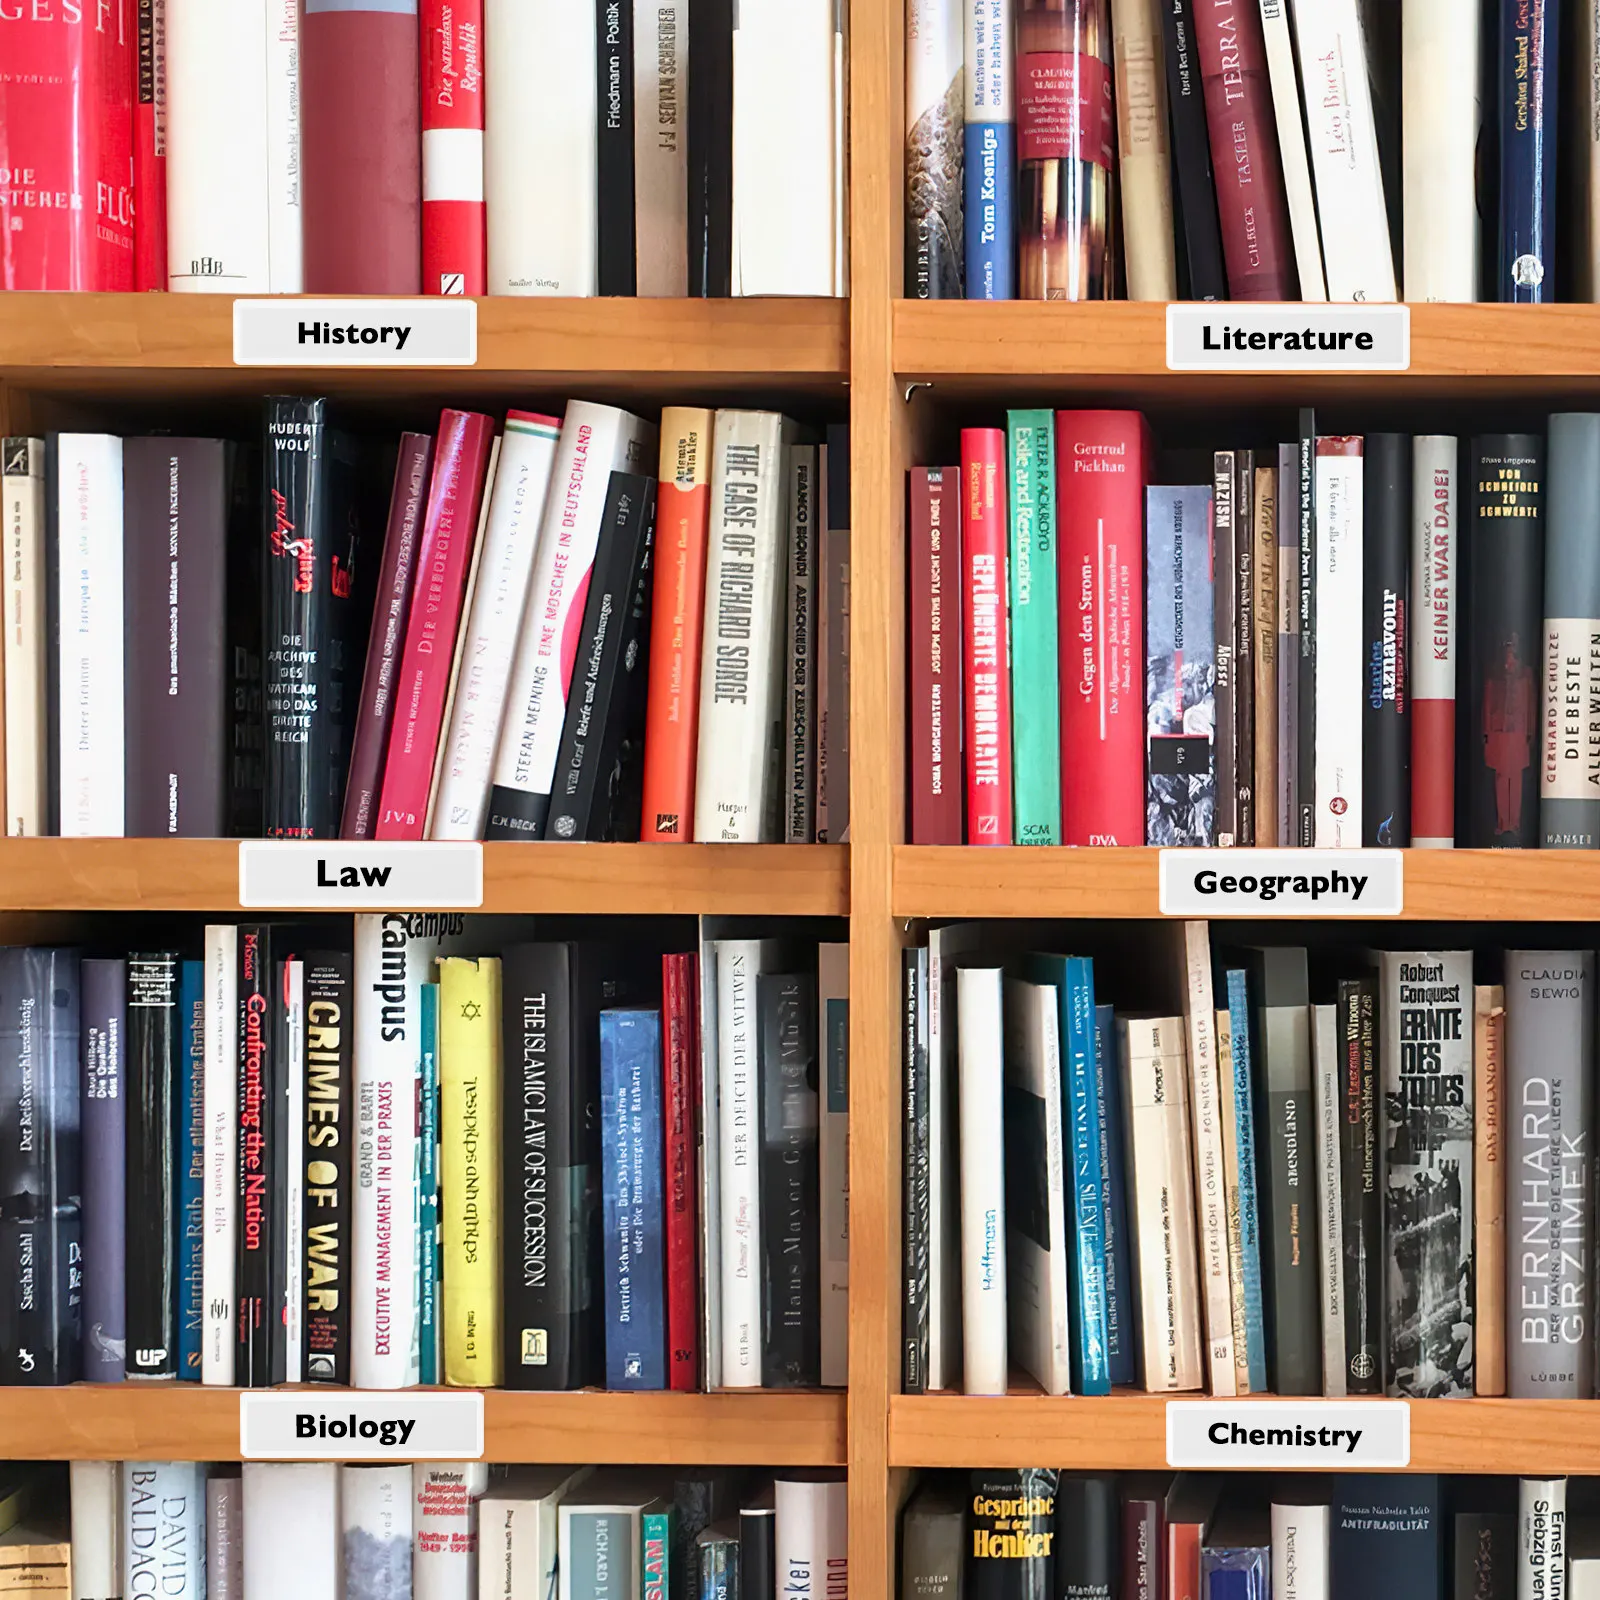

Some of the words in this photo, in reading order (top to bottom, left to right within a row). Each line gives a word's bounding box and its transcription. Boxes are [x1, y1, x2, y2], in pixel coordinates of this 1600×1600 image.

[605, 2, 621, 44] Politik
[1218, 16, 1245, 106] TERRA
[606, 57, 621, 129] Friedmann
[981, 128, 998, 200] Koenigs
[981, 205, 995, 244] Tom
[298, 322, 412, 350] History
[1202, 325, 1374, 351] Literature
[269, 423, 318, 436] HUBERT
[1074, 442, 1126, 456] Gertrud
[556, 424, 593, 530] DEUTSCHLAND
[726, 443, 760, 476] THE
[1074, 460, 1126, 473] Pickhan
[723, 481, 758, 528] CASE
[1017, 469, 1032, 503] and
[1215, 472, 1230, 528] NAZISM
[554, 532, 573, 548] IN
[1038, 482, 1050, 552] ACKROYD
[721, 532, 756, 557] OF
[1434, 534, 1448, 582] WAR
[544, 552, 570, 620] MOSCHEE
[717, 561, 755, 639] RICHARD
[972, 553, 999, 666] GEPLÜNDERTE
[538, 626, 557, 656] EINE
[1078, 615, 1093, 642] den
[1382, 588, 1397, 701] aznavour
[1433, 588, 1448, 661] KEINER
[714, 644, 750, 704] SORGE
[1548, 632, 1559, 703] SCHULZE
[1566, 657, 1580, 718] BESTE
[1589, 633, 1600, 714] WELTEN
[294, 699, 318, 711] DAS
[523, 665, 548, 726] MEINING
[581, 681, 596, 703] und
[974, 672, 998, 786] DEMOKRATIE
[1547, 708, 1558, 783] GERHARD
[1565, 726, 1579, 760] DIE
[515, 729, 537, 783] STEFAN
[1588, 722, 1600, 786] ALLER
[1089, 834, 1118, 846] DVA
[317, 860, 392, 888] Law
[1193, 869, 1369, 901] Geography
[373, 914, 408, 1043] campus
[1400, 963, 1444, 982] Robert
[1400, 984, 1460, 1005] Conquest
[1520, 970, 1586, 980] CLAUDIA
[524, 993, 546, 1029] THE
[1400, 1008, 1462, 1041] ERNTE
[241, 993, 266, 1128] Confronting
[524, 1032, 546, 1105] ISLAMIC
[733, 1031, 746, 1067] DER
[1400, 1043, 1441, 1074] DES
[308, 1001, 341, 1148] CRIMES
[377, 1081, 393, 1130] PRAXIS
[524, 1108, 546, 1149] LAW
[20, 1128, 33, 1152] Der
[246, 1131, 263, 1170] the
[377, 1134, 392, 1160] DER
[734, 1133, 747, 1167] DER
[307, 1160, 339, 1208] OF
[377, 1166, 391, 1181] IN
[524, 1151, 546, 1177] OF
[246, 1173, 266, 1250] Nation
[1522, 1076, 1550, 1344] BERNHARD
[1550, 1187, 1560, 1213] DIE
[376, 1186, 391, 1282] MANAGEMENT
[524, 1178, 546, 1287] SUCCESSION
[1550, 1219, 1560, 1250] DER
[1560, 1131, 1587, 1344] GRZIMEK
[307, 1222, 340, 1312] WAR
[375, 1287, 391, 1356] EXECUTIVE
[1551, 1312, 1561, 1344] DER
[295, 1415, 416, 1446] Biology
[1208, 1422, 1363, 1453] Chemistry
[162, 1496, 187, 1596] DAVID
[595, 1519, 609, 1582] RICHARD
[1530, 1500, 1549, 1566] Siebzig
[1551, 1510, 1565, 1559] Ernst
